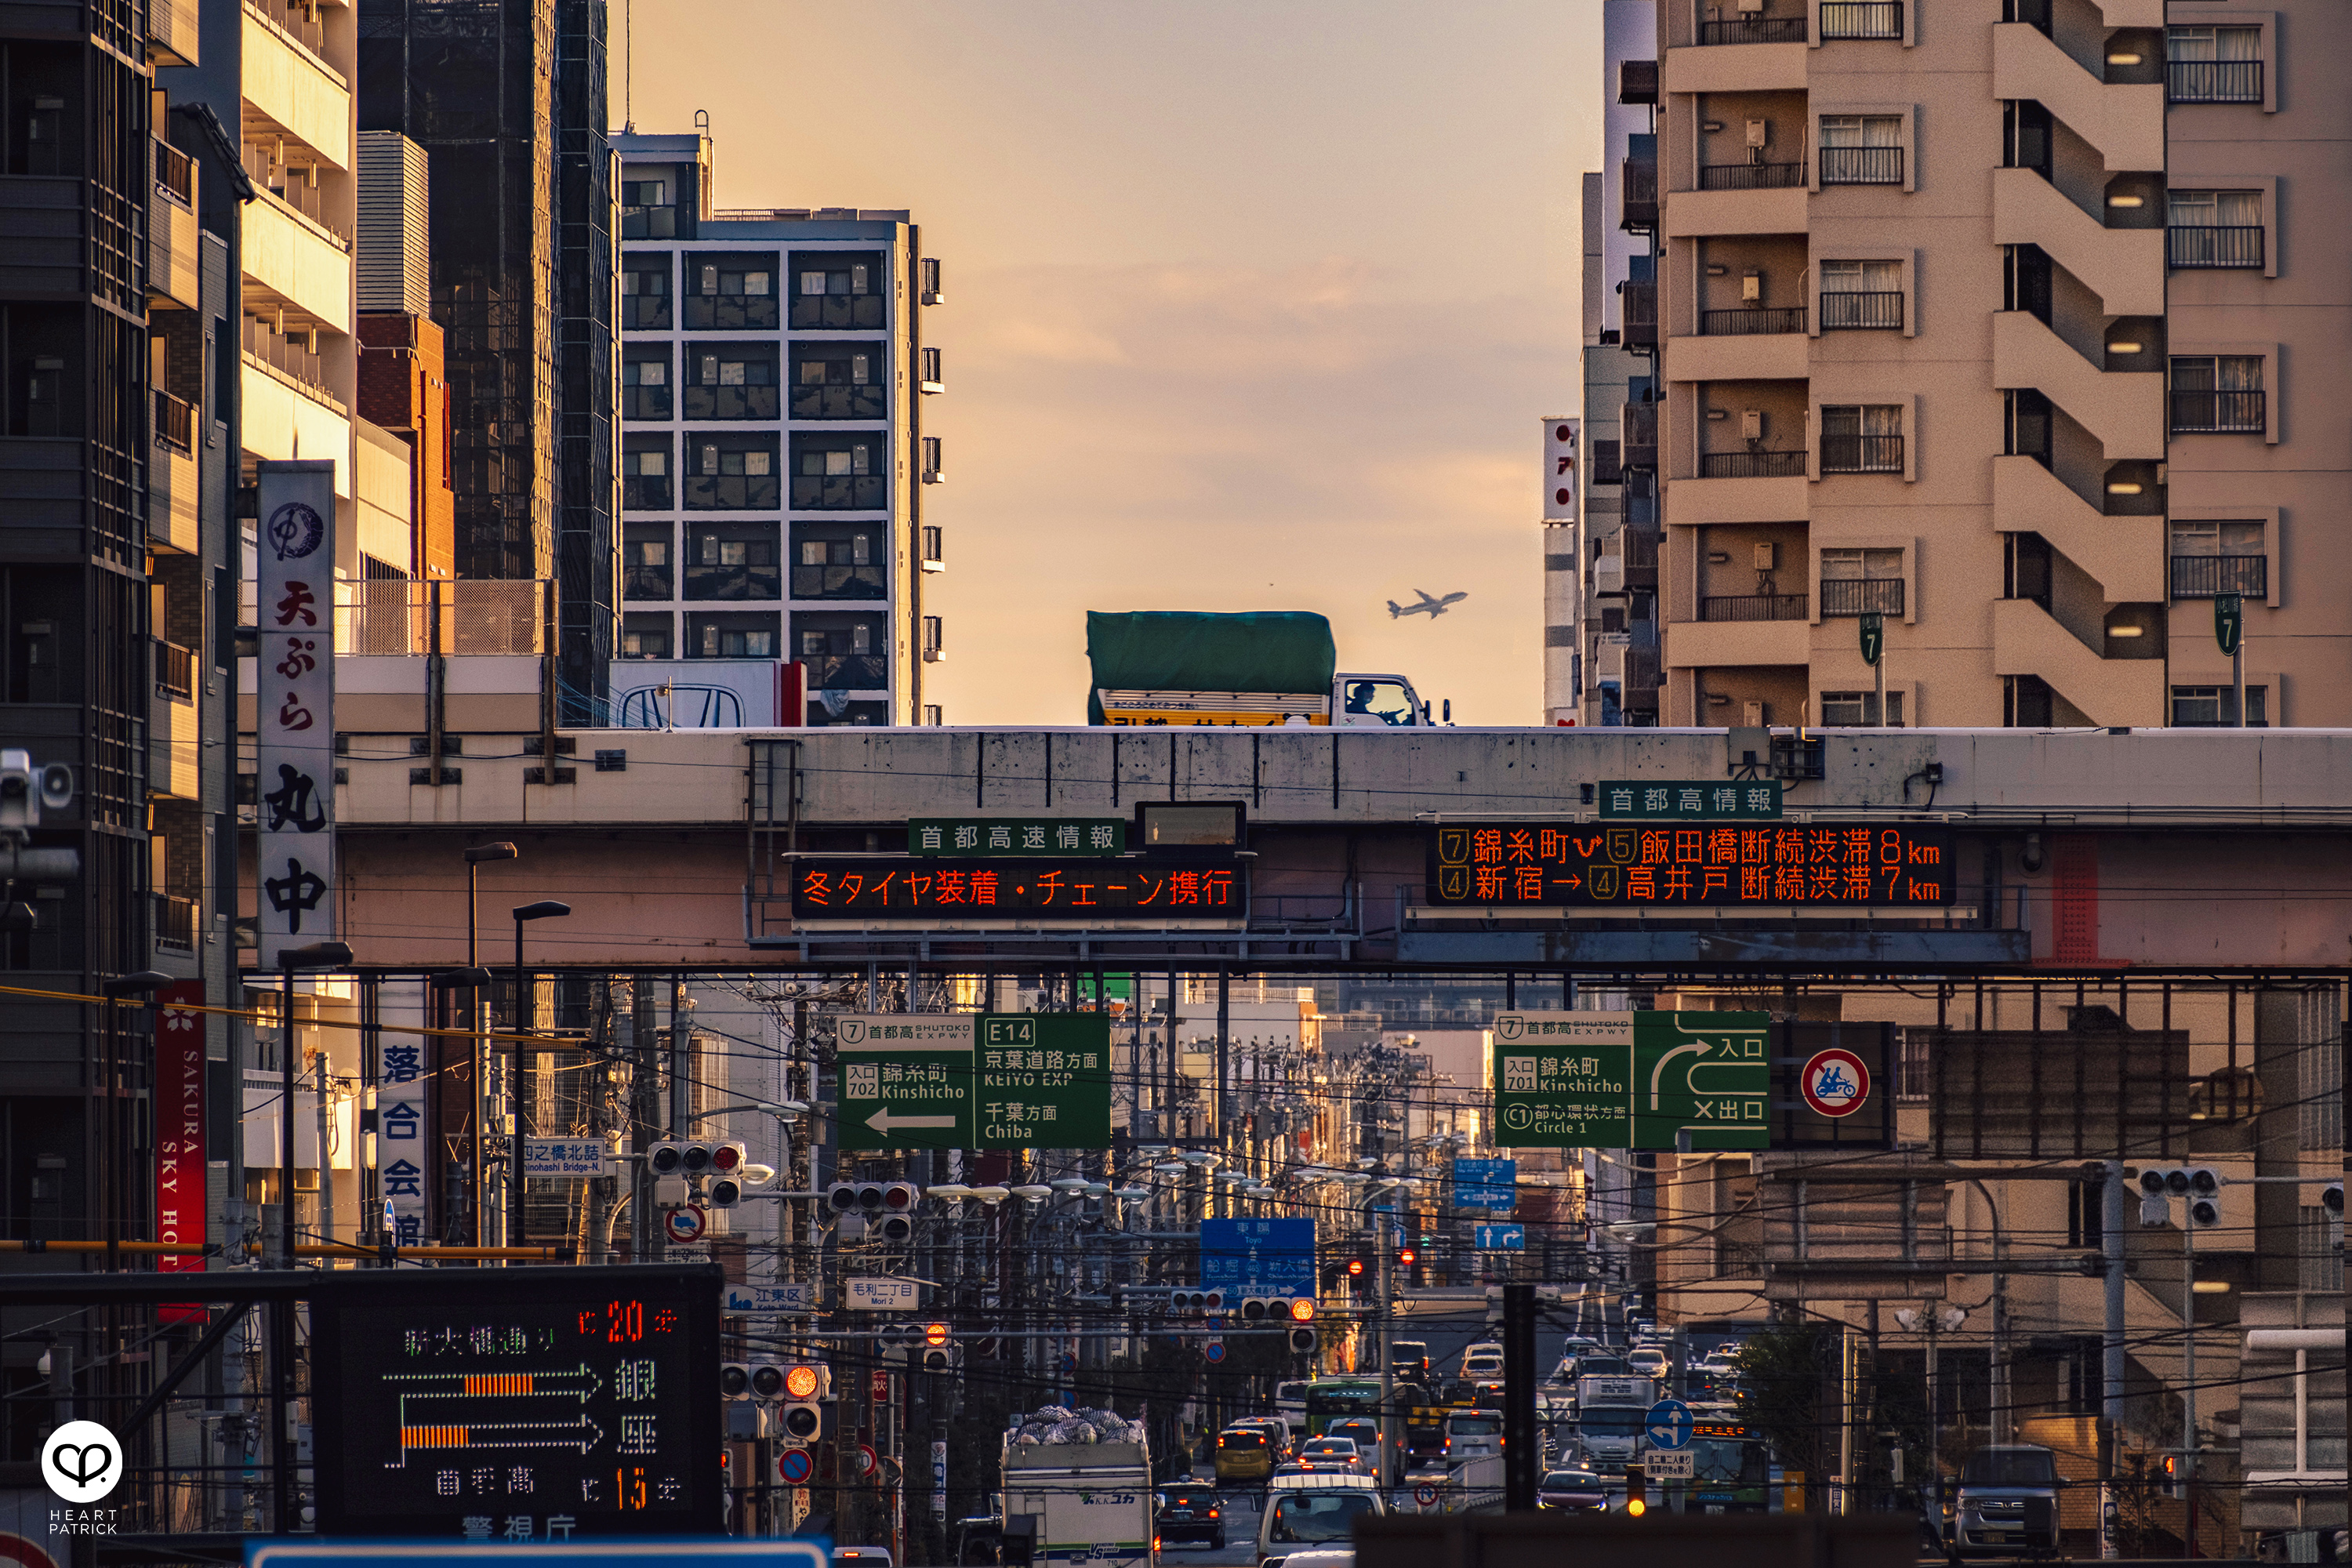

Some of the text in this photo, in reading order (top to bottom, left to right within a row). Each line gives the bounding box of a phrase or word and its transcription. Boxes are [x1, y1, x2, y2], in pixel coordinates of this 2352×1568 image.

[2223, 619, 2232, 647] 7
[1867, 634, 1875, 659] 7
[275, 581, 318, 731] 天ぷら
[1610, 787, 1772, 813] 首都高情報
[920, 825, 1115, 850] 首都高速情報
[263, 764, 327, 935] 丸中
[1447, 833, 1461, 862] 7
[1473, 829, 1567, 865] 錦糸町
[1614, 833, 1630, 858] 5
[1639, 829, 1871, 865] 飯田橋断続渋滞
[802, 869, 1233, 906] 冬タイヤ装着・チェーン携行
[1447, 869, 1461, 895] 4
[1475, 866, 1543, 901] 新宿
[1597, 869, 1612, 895] 4
[848, 1025, 858, 1039] 7
[869, 1025, 913, 1040] 首都高
[990, 1024, 1032, 1041] E14
[1506, 1020, 1515, 1034] 7
[1526, 1021, 1572, 1036] 首都高
[1719, 1038, 1763, 1058] 入口
[985, 1051, 1098, 1069] 京葉道路方面
[1508, 1061, 1534, 1074] 入口
[1541, 1057, 1600, 1077] 錦糸町
[849, 1066, 876, 1080] 入口
[882, 1062, 949, 1083] 錦糸町
[985, 1073, 1074, 1087] KEIYO EXP
[849, 1083, 877, 1097] 702
[882, 1084, 965, 1099] Kinshicho
[1508, 1076, 1535, 1091] 701
[1541, 1079, 1623, 1094] Kinshicho
[183, 1051, 199, 1155] SAKURA
[1719, 1100, 1762, 1121] 出口
[985, 1102, 1058, 1122] 千葉方面
[1509, 1109, 1527, 1125] C1
[1534, 1104, 1626, 1121] 都心環状方面
[985, 1124, 1033, 1138] Chiba
[1534, 1122, 1587, 1134] Circle 1
[383, 1045, 421, 1247] 落合会館
[162, 1142, 177, 1193] SKY
[563, 1163, 601, 1173] Bridge-N.
[1236, 1221, 1270, 1236] 東陽
[1245, 1236, 1262, 1245] Toyo
[1207, 1259, 1239, 1272] 船堀
[1269, 1259, 1311, 1272] 新大橋
[755, 1288, 801, 1302] 江東区
[853, 1284, 912, 1298] 毛利二丁目
[1648, 1455, 1691, 1465] 自二輪二人乗り
[462, 1515, 576, 1544] 警視庁
